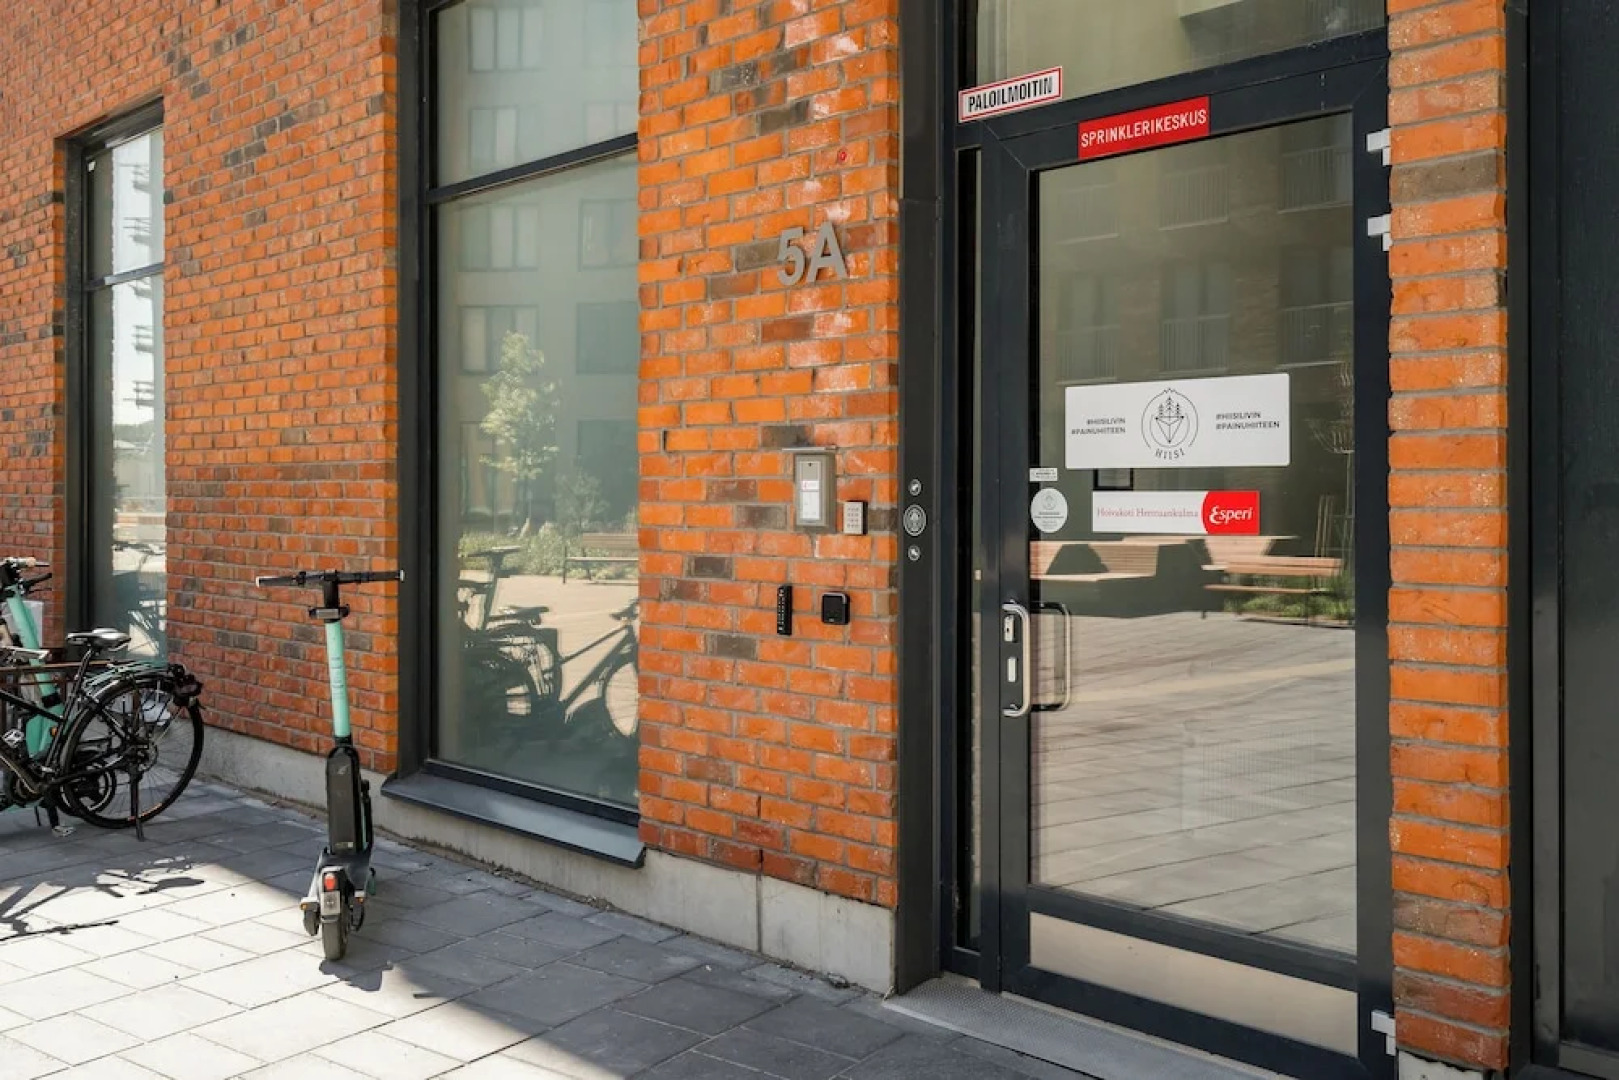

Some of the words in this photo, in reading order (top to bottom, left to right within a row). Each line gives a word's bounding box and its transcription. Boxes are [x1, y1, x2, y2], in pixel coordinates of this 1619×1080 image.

[967, 75, 1054, 113] PALOILMOITIN
[1080, 108, 1207, 148] SPRINKLERIKESKUS
[777, 221, 848, 286] 5A
[1155, 448, 1185, 461] HIISI
[1209, 505, 1254, 525] Esperi
